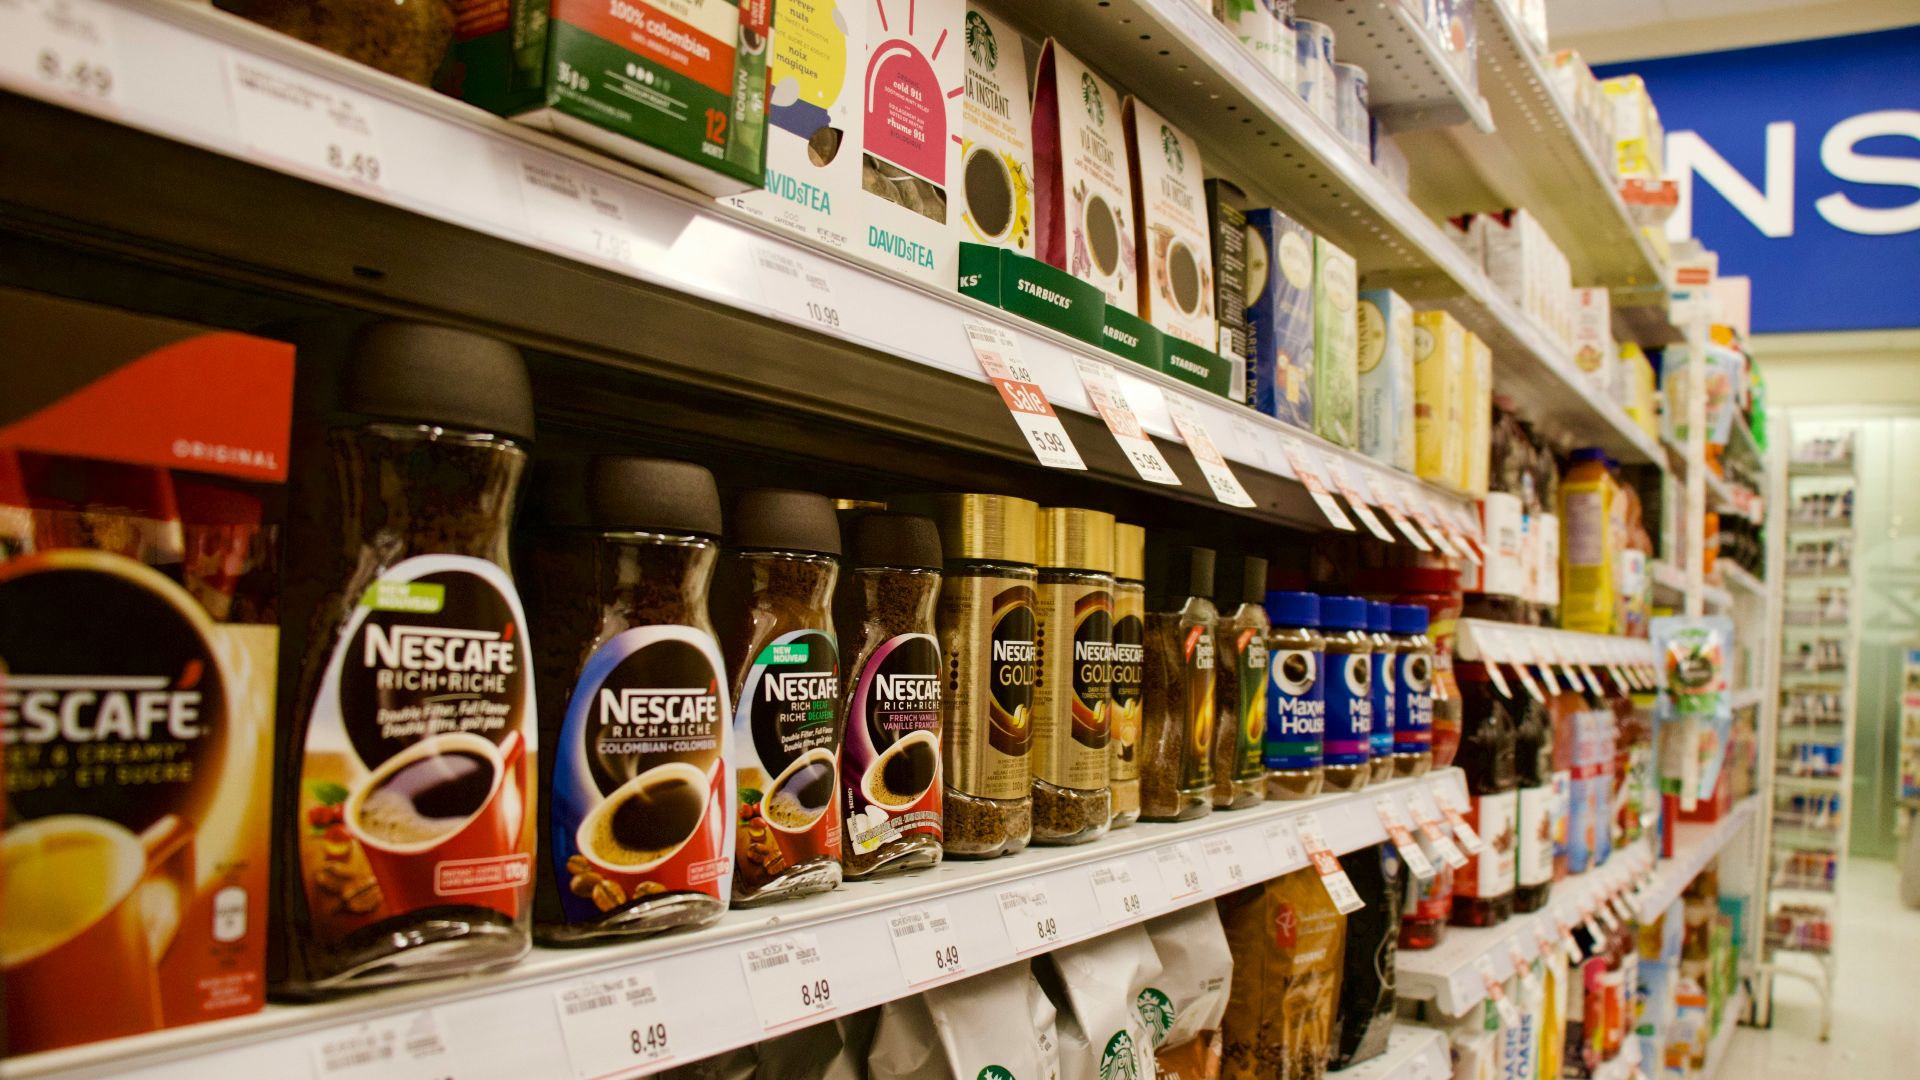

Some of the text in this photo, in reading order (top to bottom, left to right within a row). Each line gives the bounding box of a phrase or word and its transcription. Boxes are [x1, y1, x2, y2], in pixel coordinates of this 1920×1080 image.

[893, 80, 923, 102] cold 911
[705, 107, 728, 145] 12
[887, 117, 925, 142] rhume 911
[764, 168, 831, 216] AVIDsTEA
[1017, 278, 1072, 310] STARBUCKS
[806, 300, 840, 327] 10.99
[1102, 324, 1138, 348] ARBUCKS
[1009, 365, 1032, 383] 8.49
[1003, 381, 1047, 414] Sale
[1031, 429, 1066, 453] 5.99
[172, 438, 279, 471] ORIGINAL
[1132, 450, 1163, 472] 5.99
[364, 622, 515, 674] NESCAFÉ
[993, 639, 1036, 662] NESCAF
[1000, 664, 1036, 686] GOLD
[600, 678, 719, 725] NESCAFÉ
[791, 701, 811, 712] RICH
[780, 712, 807, 723] RICHE
[882, 721, 914, 731] VANILLE
[889, 713, 918, 723] FRENCH
[781, 733, 801, 745] Double
[1123, 894, 1141, 913] 8.49
[1037, 917, 1057, 939] 8.49
[935, 945, 959, 969] 8.49
[801, 978, 830, 1006] 8.49
[631, 1022, 667, 1054] 8.49
